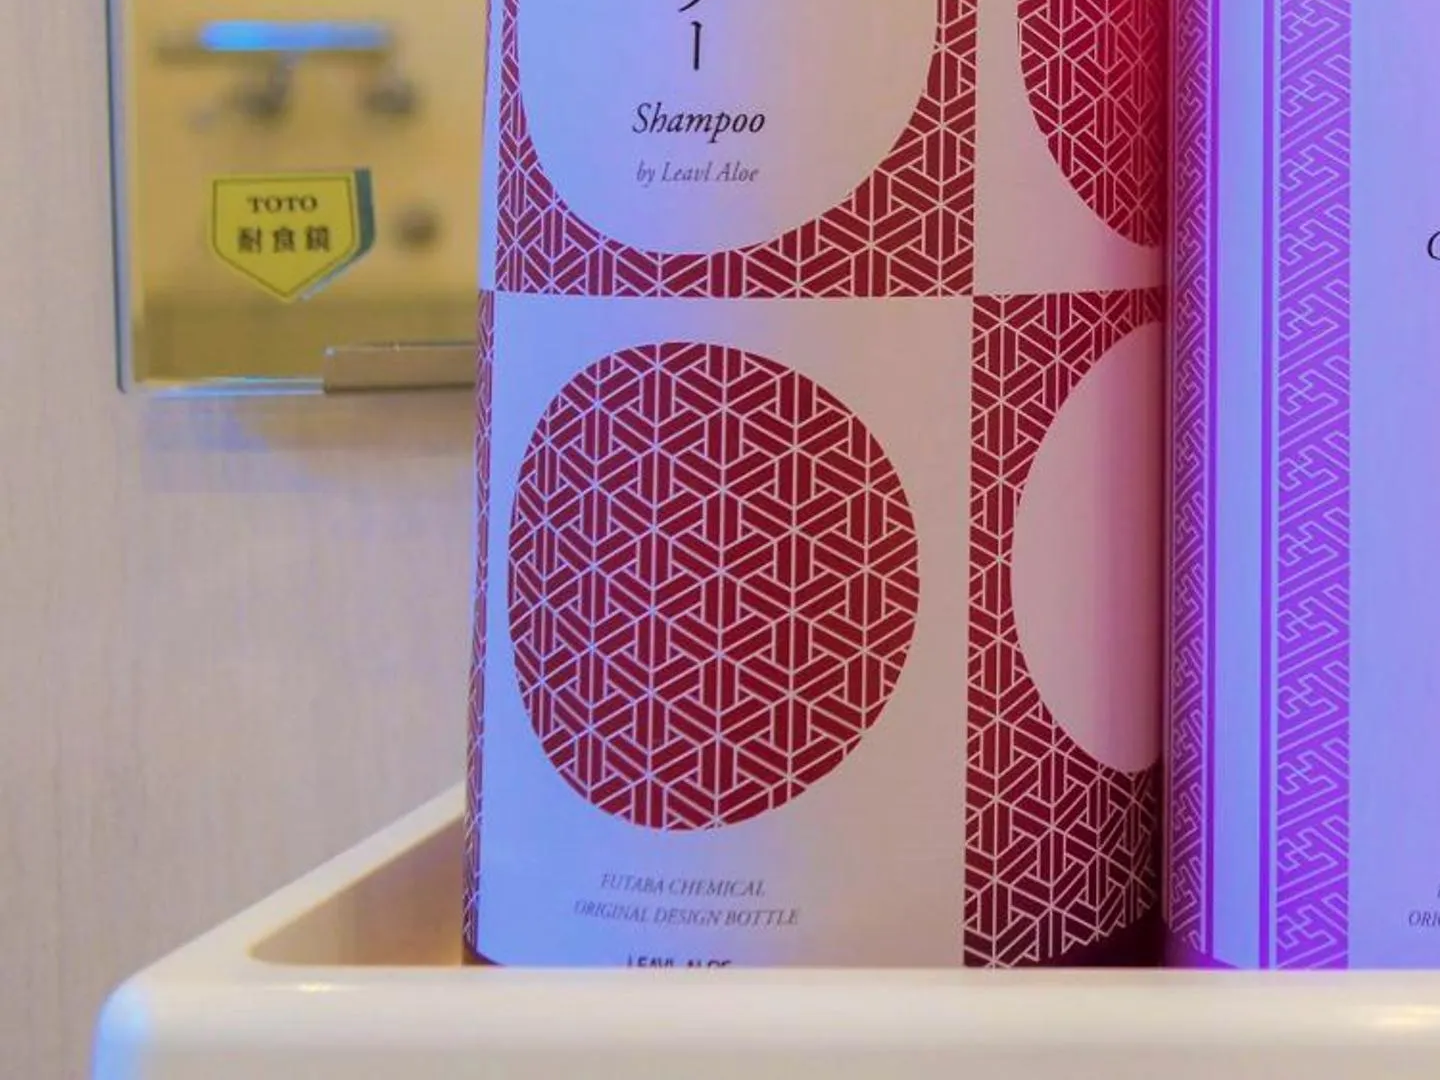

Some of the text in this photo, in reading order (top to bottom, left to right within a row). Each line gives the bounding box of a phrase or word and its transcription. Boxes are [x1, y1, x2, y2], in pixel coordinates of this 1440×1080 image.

[631, 101, 766, 144] Shampoo
[636, 159, 656, 188] by
[716, 160, 760, 182] Aloe
[246, 196, 318, 214] TOTO
[600, 873, 767, 898] FUTABA CHEMICAL
[573, 899, 802, 927] ORIGINAL DESIGN BOTTLE
